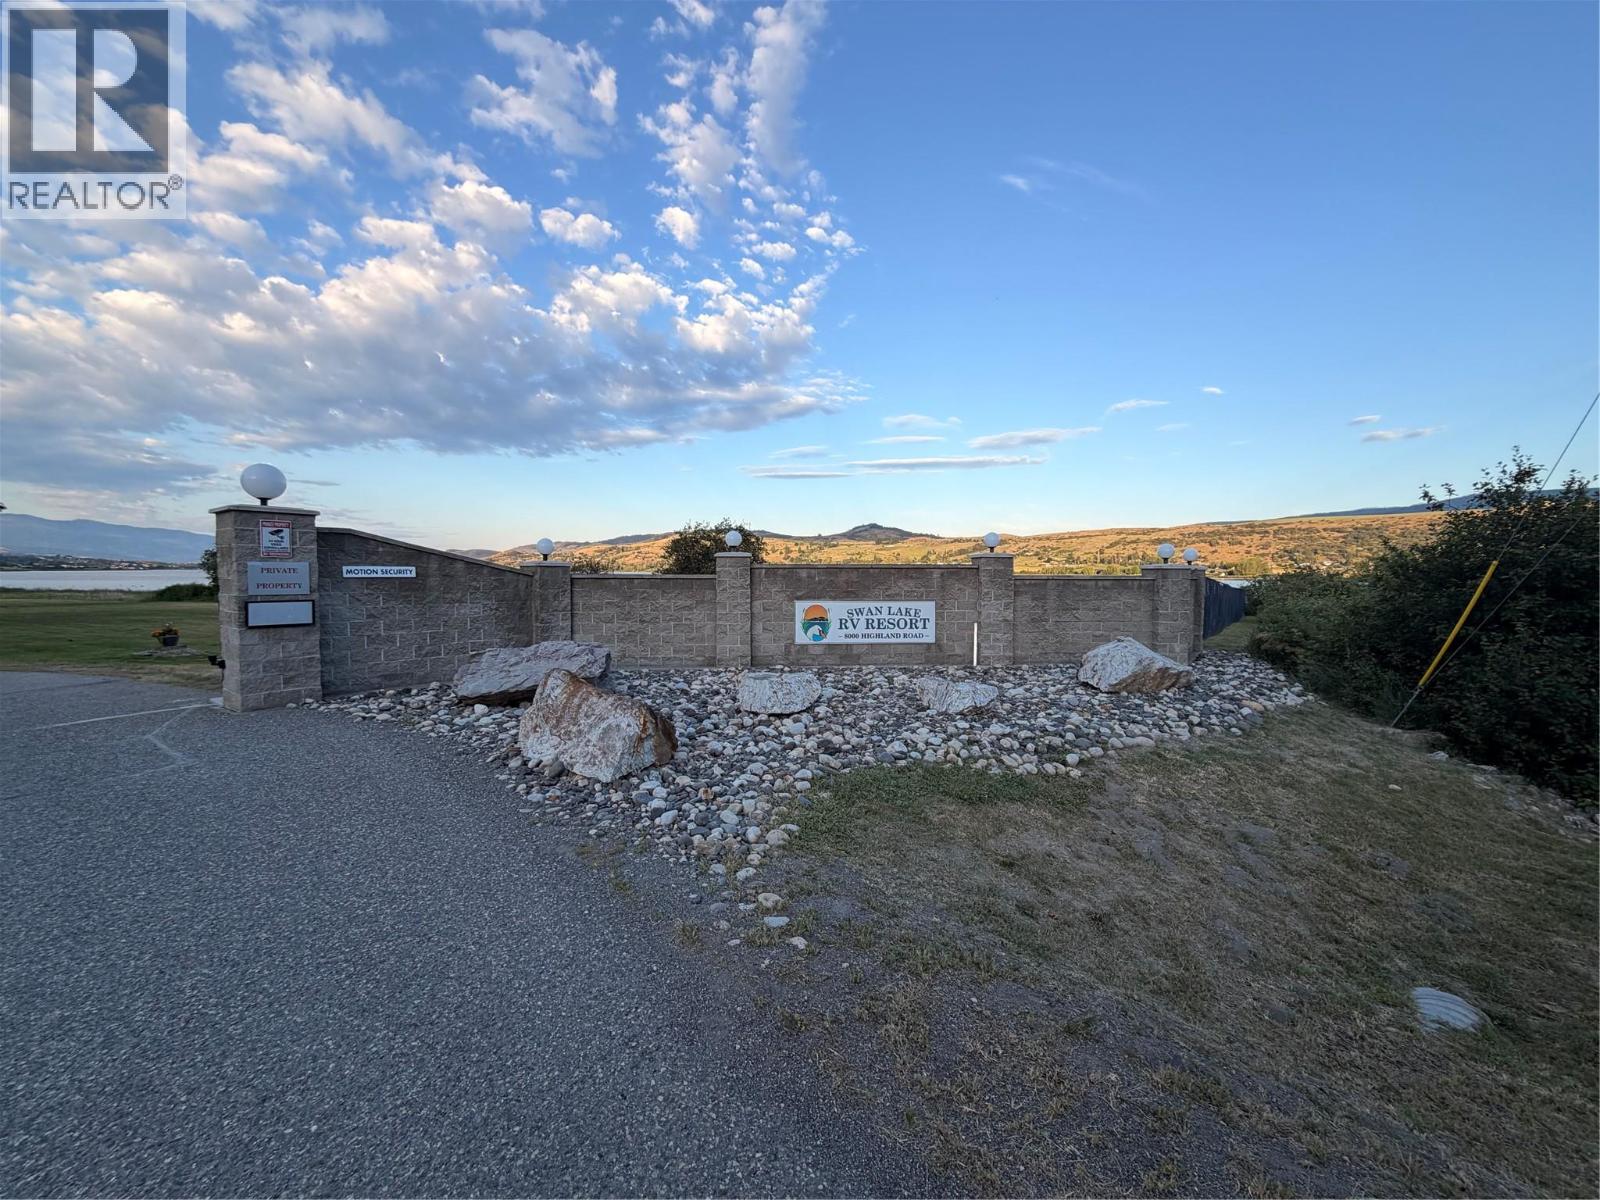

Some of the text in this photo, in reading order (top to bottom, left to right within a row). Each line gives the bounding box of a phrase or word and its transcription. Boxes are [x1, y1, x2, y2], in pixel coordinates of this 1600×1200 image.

[260, 567, 299, 575] PRIVATE
[345, 568, 413, 576] MOTION SECURITY
[256, 582, 303, 590] PROPERTY
[846, 606, 922, 618] SWAN LAKE
[838, 617, 931, 630] RV RESORT
[861, 632, 901, 640] HIGHLAND
